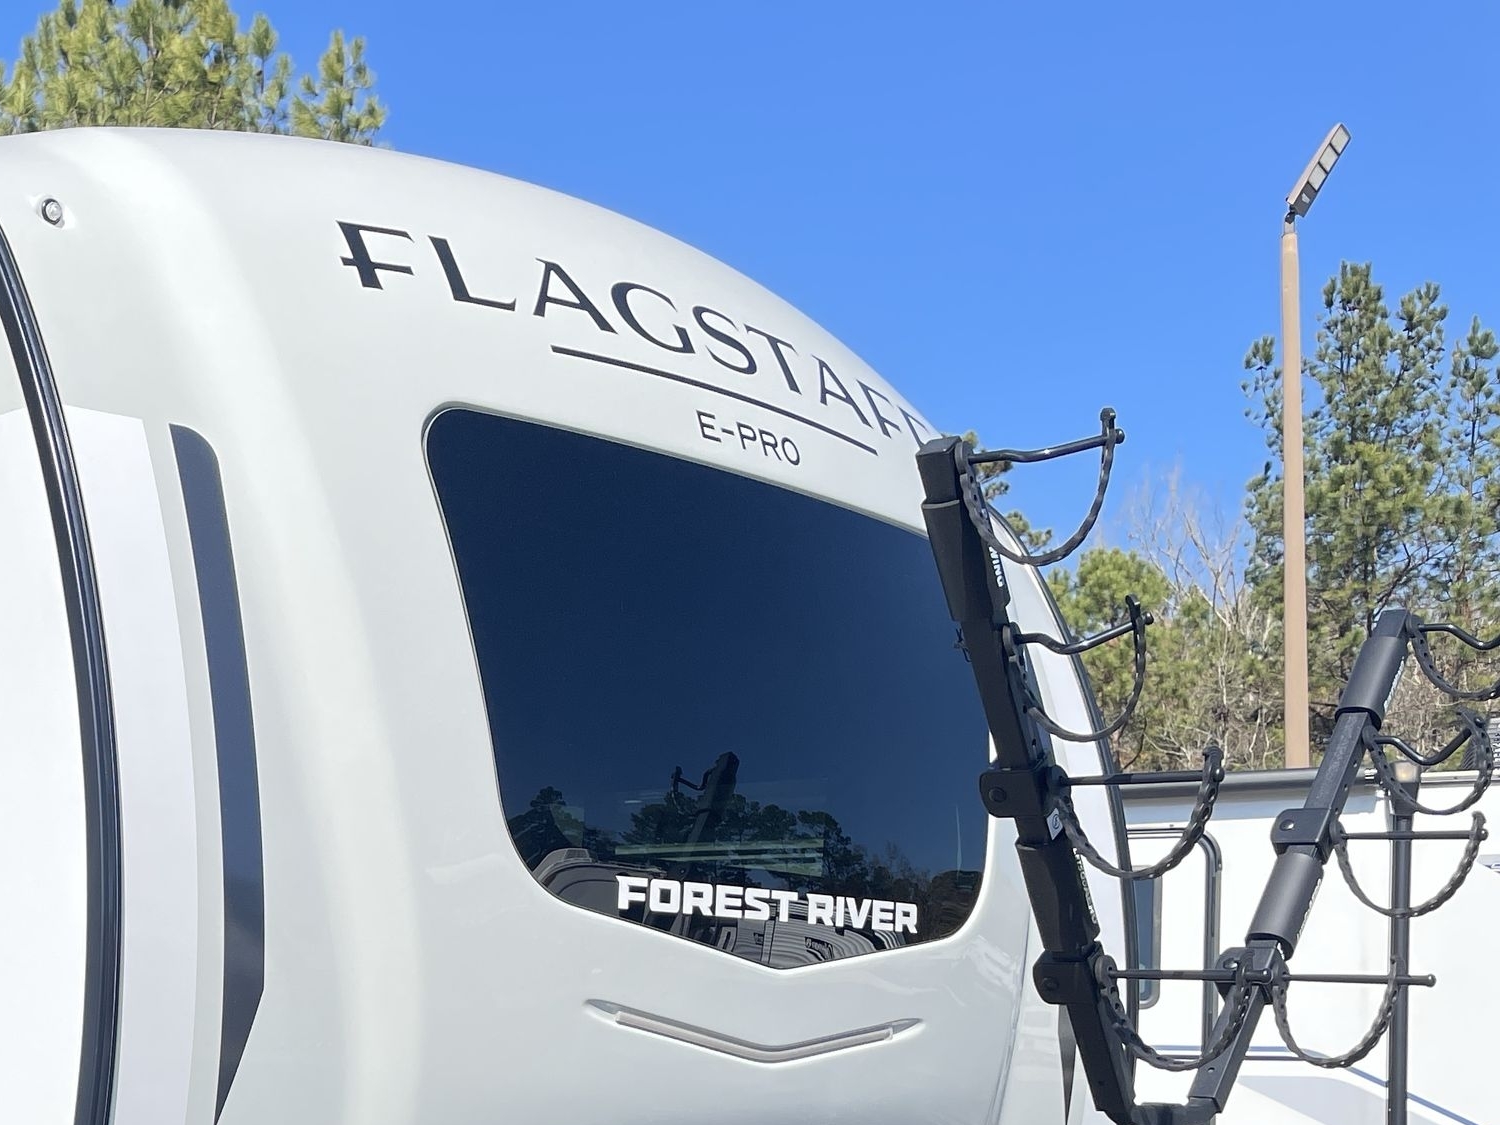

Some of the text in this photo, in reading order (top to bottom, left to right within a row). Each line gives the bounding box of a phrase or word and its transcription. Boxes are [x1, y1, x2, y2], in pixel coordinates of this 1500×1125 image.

[335, 219, 931, 450] FLAGSTAFF
[696, 410, 800, 467] E-PRO
[615, 875, 919, 934] FOREST RIVER
